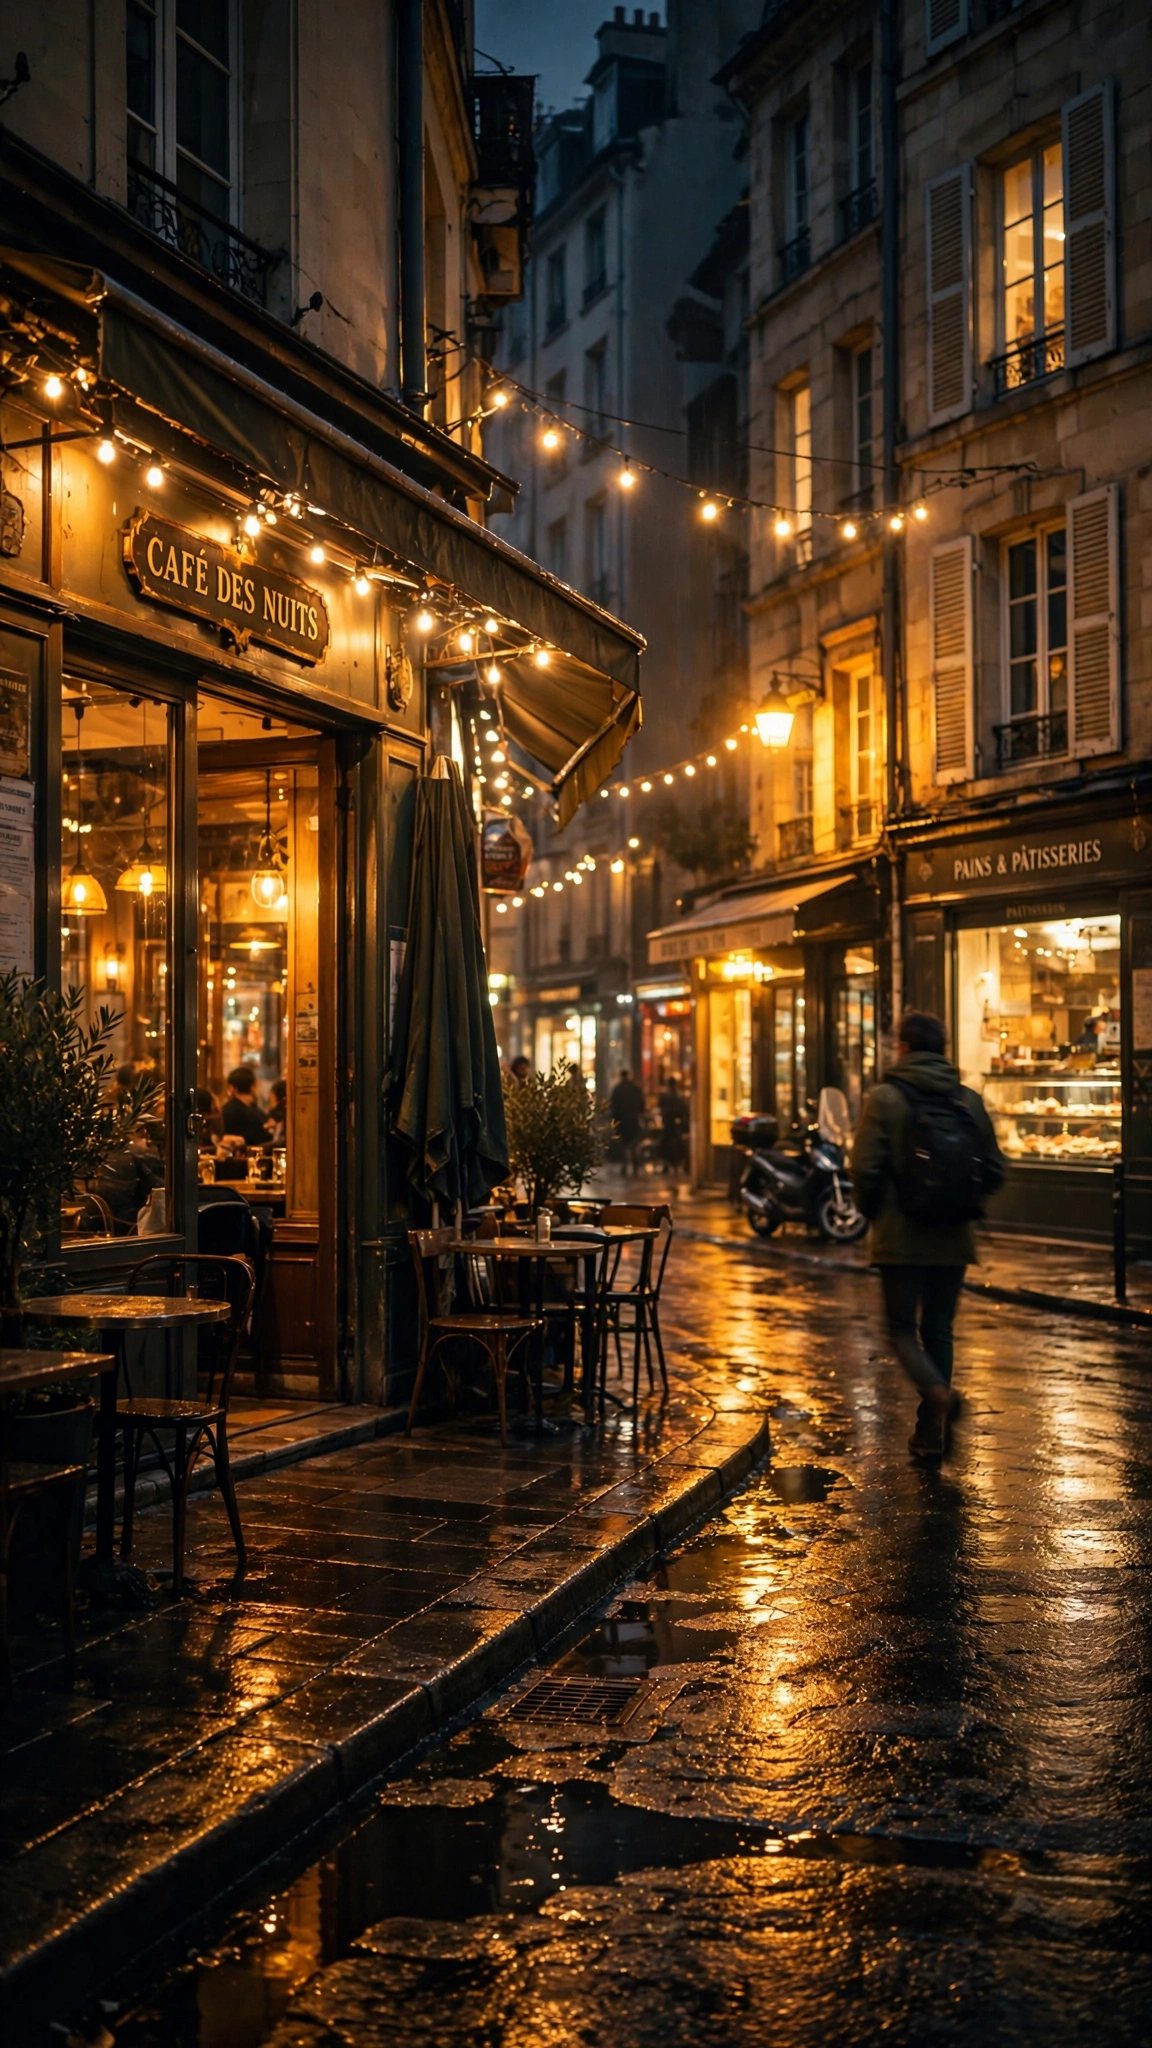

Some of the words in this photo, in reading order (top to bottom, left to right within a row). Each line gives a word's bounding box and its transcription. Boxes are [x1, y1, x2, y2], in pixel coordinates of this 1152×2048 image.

[147, 537, 208, 595] CAFÉ
[217, 566, 256, 614] DES
[263, 586, 319, 641] NUITS
[954, 856, 992, 880] PAINS
[997, 853, 1007, 874] &
[1012, 839, 1102, 873] PÂTISSERIES
